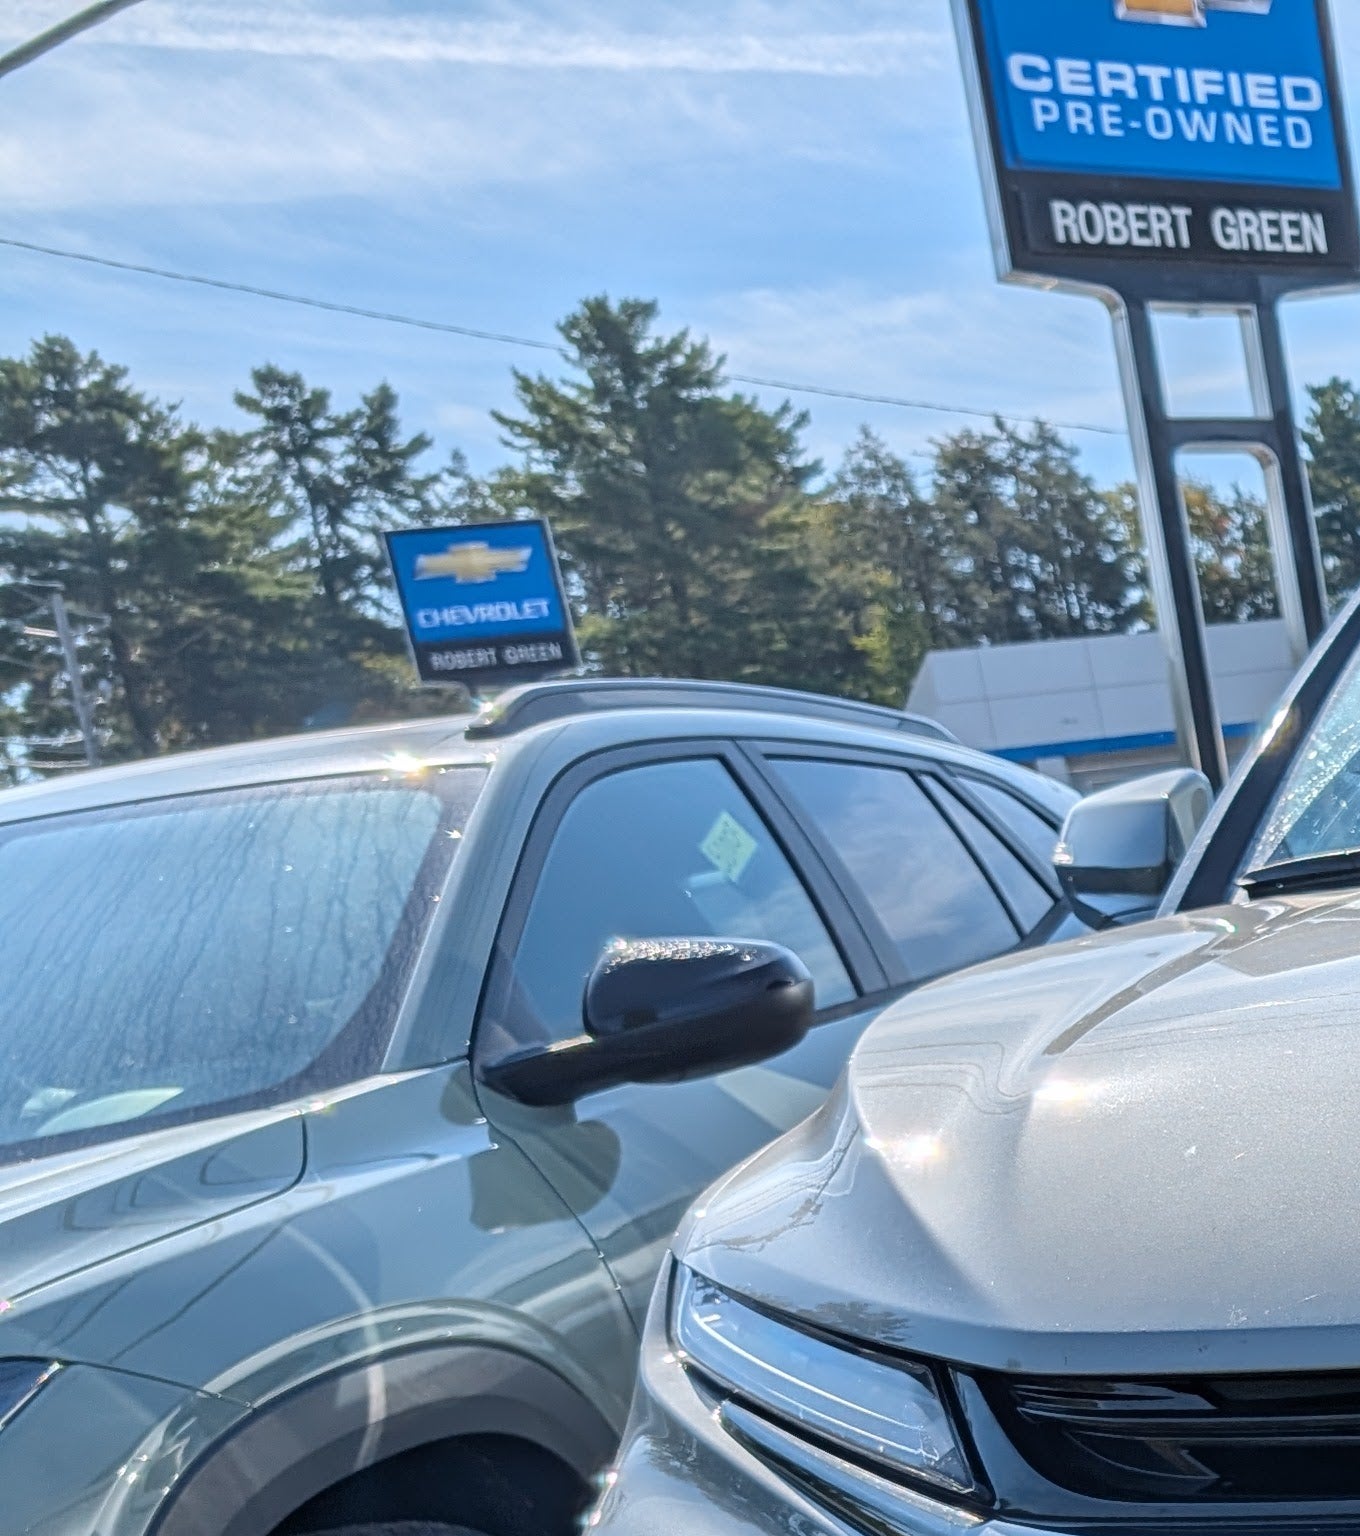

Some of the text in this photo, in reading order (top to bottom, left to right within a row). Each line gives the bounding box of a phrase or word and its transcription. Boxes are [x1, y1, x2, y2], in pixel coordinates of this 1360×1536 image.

[1007, 53, 1323, 112] CERTIFIED
[1031, 98, 1313, 149] PRE-OWNED
[1050, 200, 1329, 254] ROBERT GREEN
[416, 598, 550, 629] CHEVROLET
[430, 642, 563, 671] ROBERT GREEN
